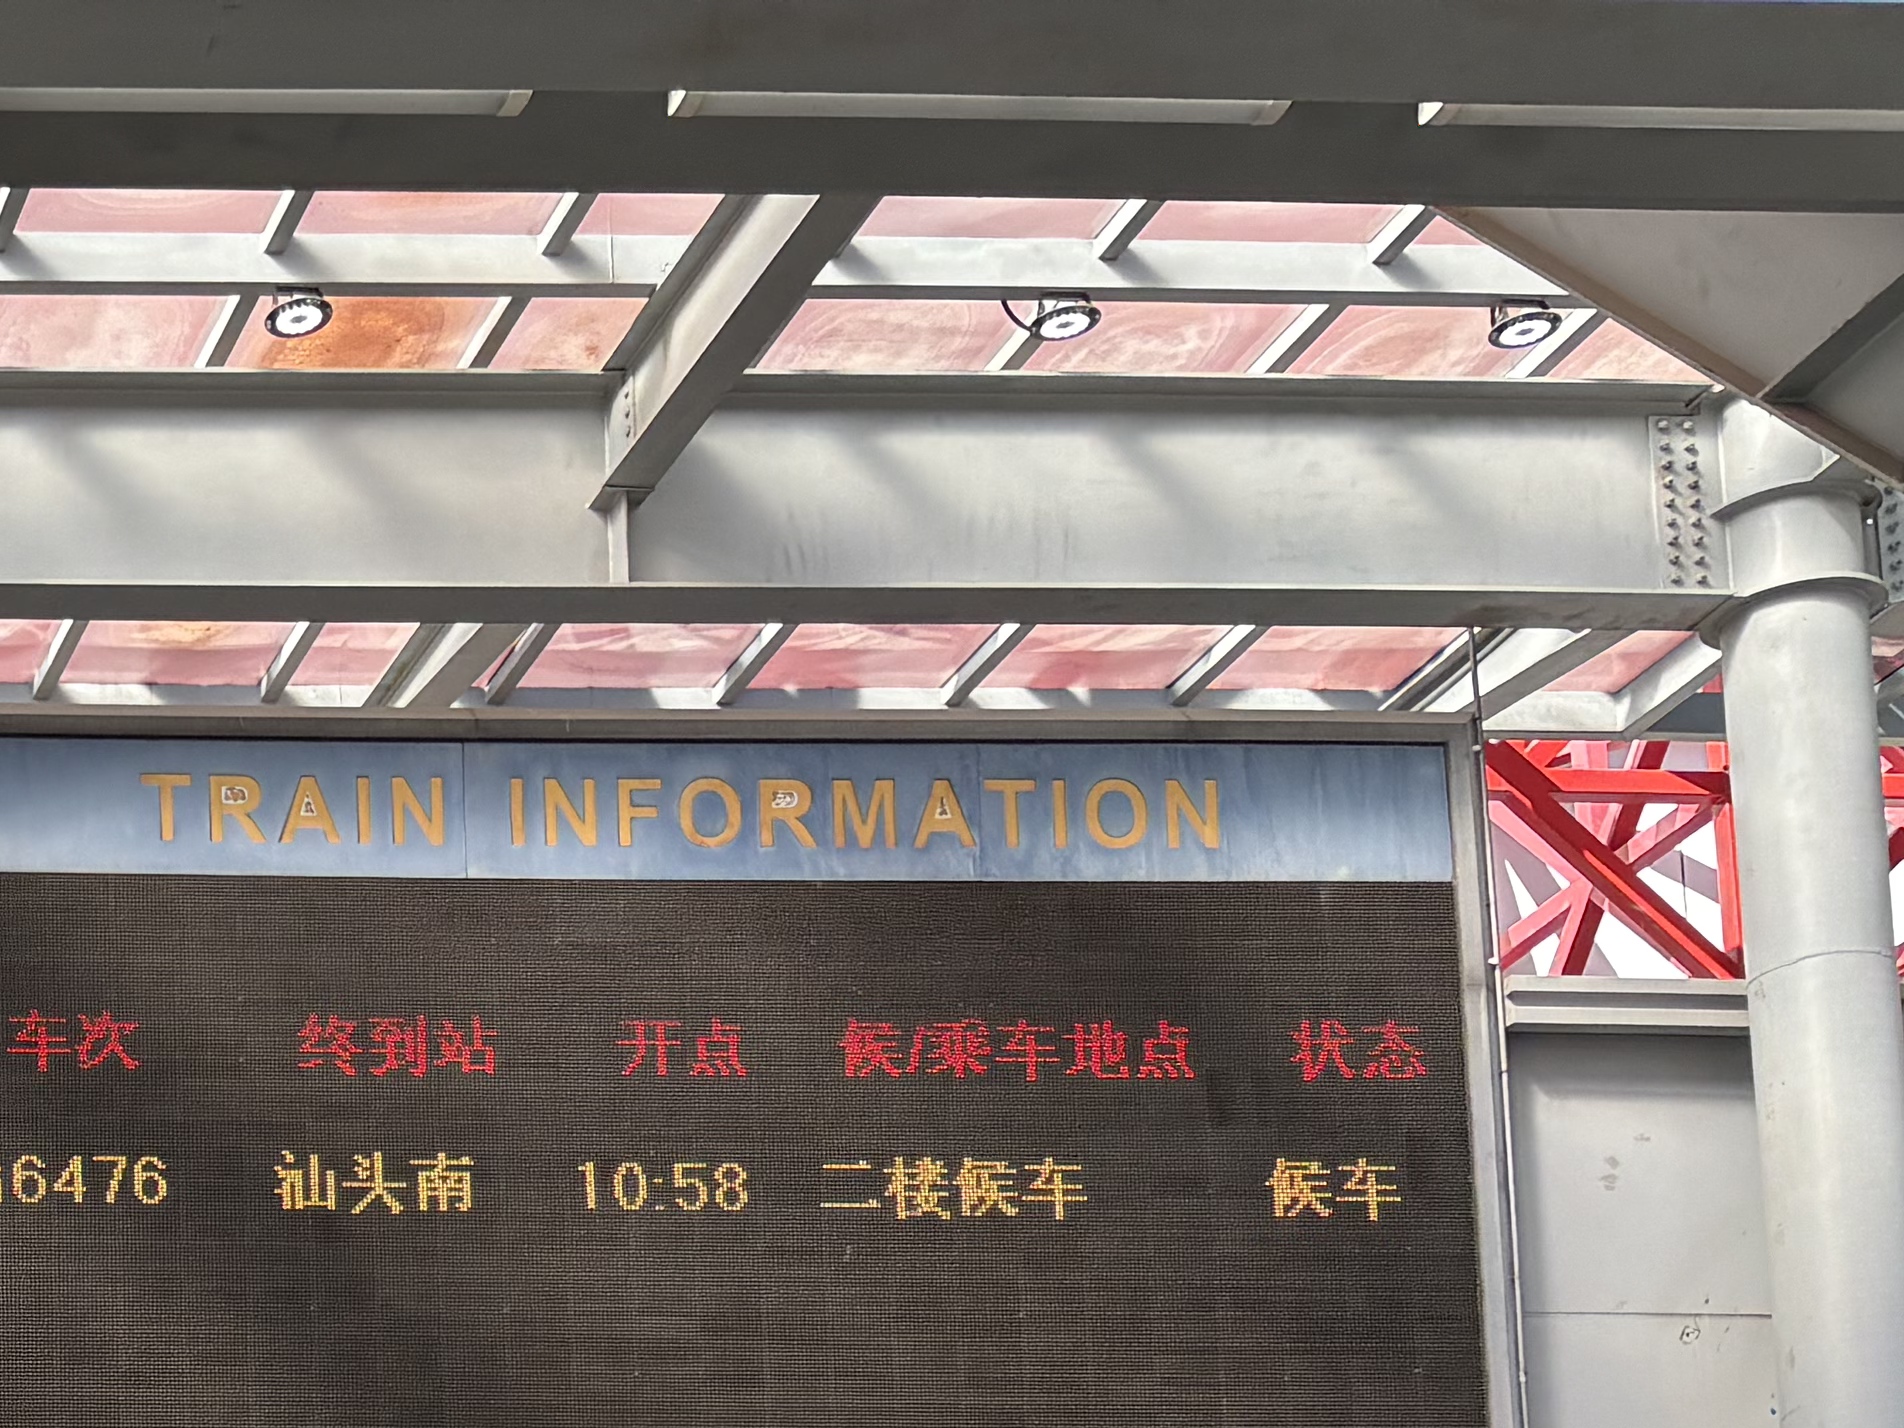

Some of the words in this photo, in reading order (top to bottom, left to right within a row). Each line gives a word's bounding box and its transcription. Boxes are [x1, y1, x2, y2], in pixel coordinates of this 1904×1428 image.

[139, 772, 445, 847] TRAIN
[509, 778, 1222, 850] INFORMATION
[5, 1008, 141, 1073] 车次
[296, 1012, 498, 1077] 终到站
[616, 1018, 747, 1077] 开点
[837, 1017, 1197, 1082] 候/乘车地点
[1290, 1020, 1429, 1082] 状态
[276, 1152, 472, 1214] 汕头南
[582, 1163, 748, 1212] 10:58
[825, 1158, 1086, 1221] 二楼候车
[1268, 1160, 1399, 1221] 候车
